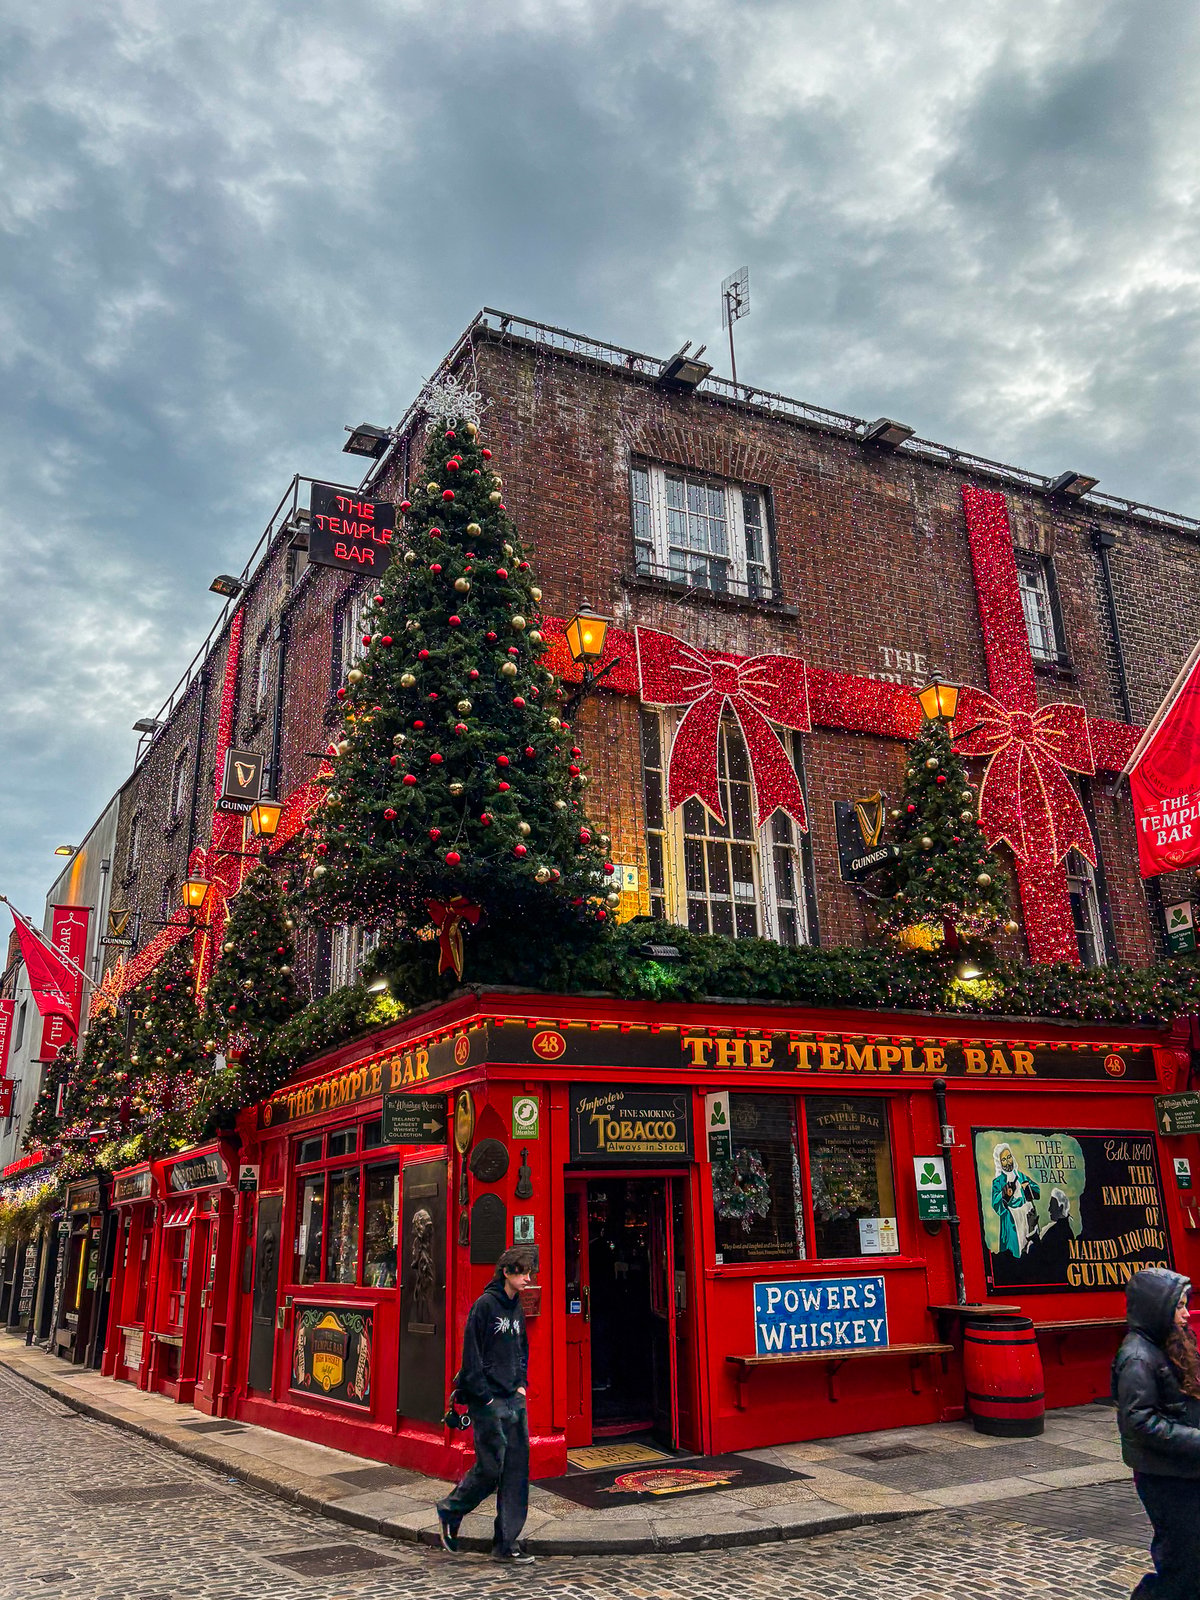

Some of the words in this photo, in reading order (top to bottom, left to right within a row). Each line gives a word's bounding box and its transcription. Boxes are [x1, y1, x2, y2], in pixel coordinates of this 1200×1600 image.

[335, 495, 375, 520] THE
[315, 514, 392, 544] TEMPLE
[334, 542, 375, 566] BAR
[878, 646, 929, 675] THE
[220, 800, 252, 812] GUINN
[1160, 794, 1190, 812] THE
[1156, 824, 1193, 846] BAR
[852, 848, 888, 871] GUINNESS
[60, 927, 73, 953] BAR
[102, 937, 133, 946] GUINNESS
[456, 1043, 468, 1061] 48
[538, 1035, 560, 1053] 48
[682, 1037, 775, 1069] THE
[789, 1041, 948, 1074] TEMPLE
[964, 1048, 1037, 1077] BAR
[1107, 1059, 1121, 1075] 48
[287, 1092, 315, 1119] THE
[320, 1067, 382, 1109] TEMPLE
[390, 1050, 430, 1088] BAR
[576, 1091, 625, 1115] Importers
[606, 1104, 616, 1112] OF
[841, 1103, 854, 1112] The
[619, 1109, 638, 1118] FINE
[639, 1109, 676, 1119] SMOKING
[816, 1112, 858, 1126] TEMPLE
[859, 1113, 880, 1127] BAR
[589, 1114, 676, 1149] TOBACCO
[608, 1142, 641, 1153] Always
[646, 1142, 654, 1151] in
[657, 1142, 684, 1152] Stock
[1035, 1140, 1063, 1155] THE
[1132, 1143, 1152, 1161] 1840
[1024, 1155, 1077, 1170] TEMPLE
[1040, 1170, 1068, 1185] BAR
[1127, 1166, 1155, 1185] THE
[1101, 1186, 1159, 1206] EMPEROR
[1145, 1206, 1159, 1226] OF
[1068, 1239, 1118, 1261] MALTED
[1117, 1227, 1166, 1256] LIQUORS
[1066, 1261, 1168, 1287] GUINN
[765, 1284, 877, 1315] POWER'S
[759, 1319, 885, 1351] WHISKEY
[314, 1340, 337, 1352] TEMPLE
